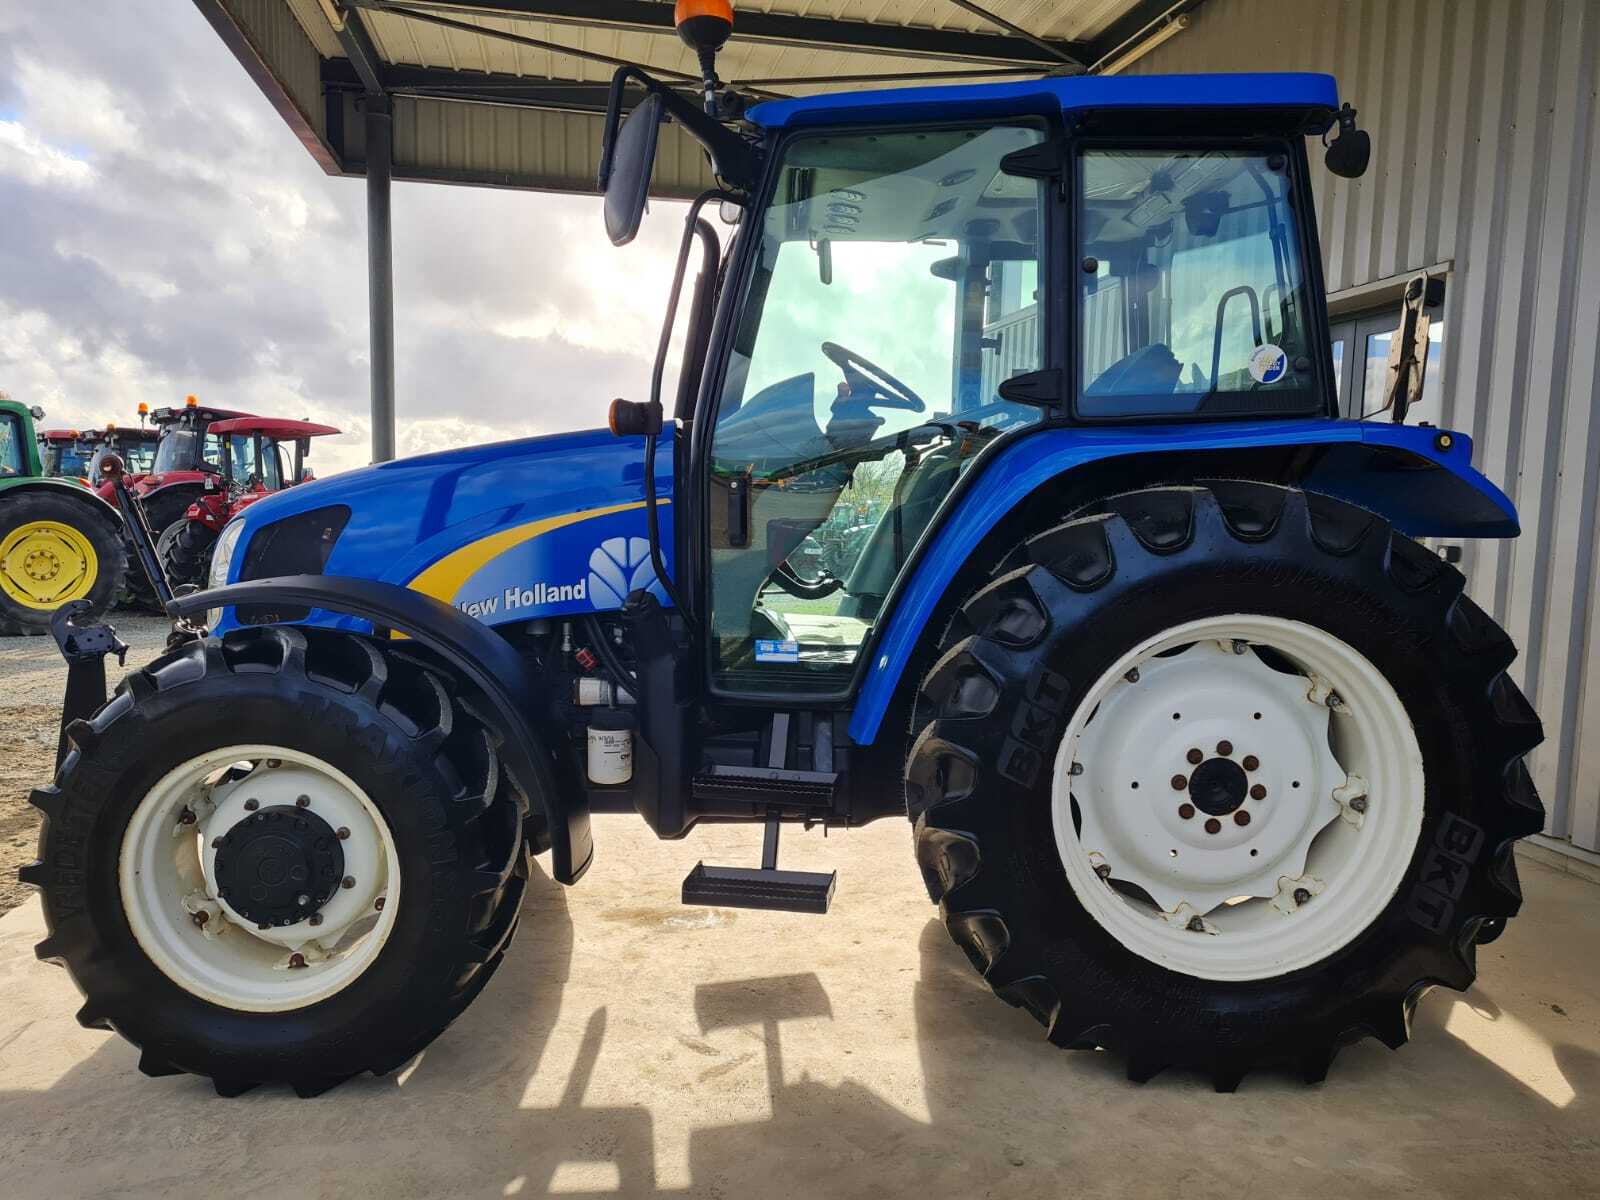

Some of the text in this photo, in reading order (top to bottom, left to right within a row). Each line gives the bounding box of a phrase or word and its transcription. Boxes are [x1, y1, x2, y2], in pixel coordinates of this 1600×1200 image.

[504, 579, 586, 609] Holland
[998, 671, 1070, 789] BKT
[1407, 811, 1485, 935] BKT
